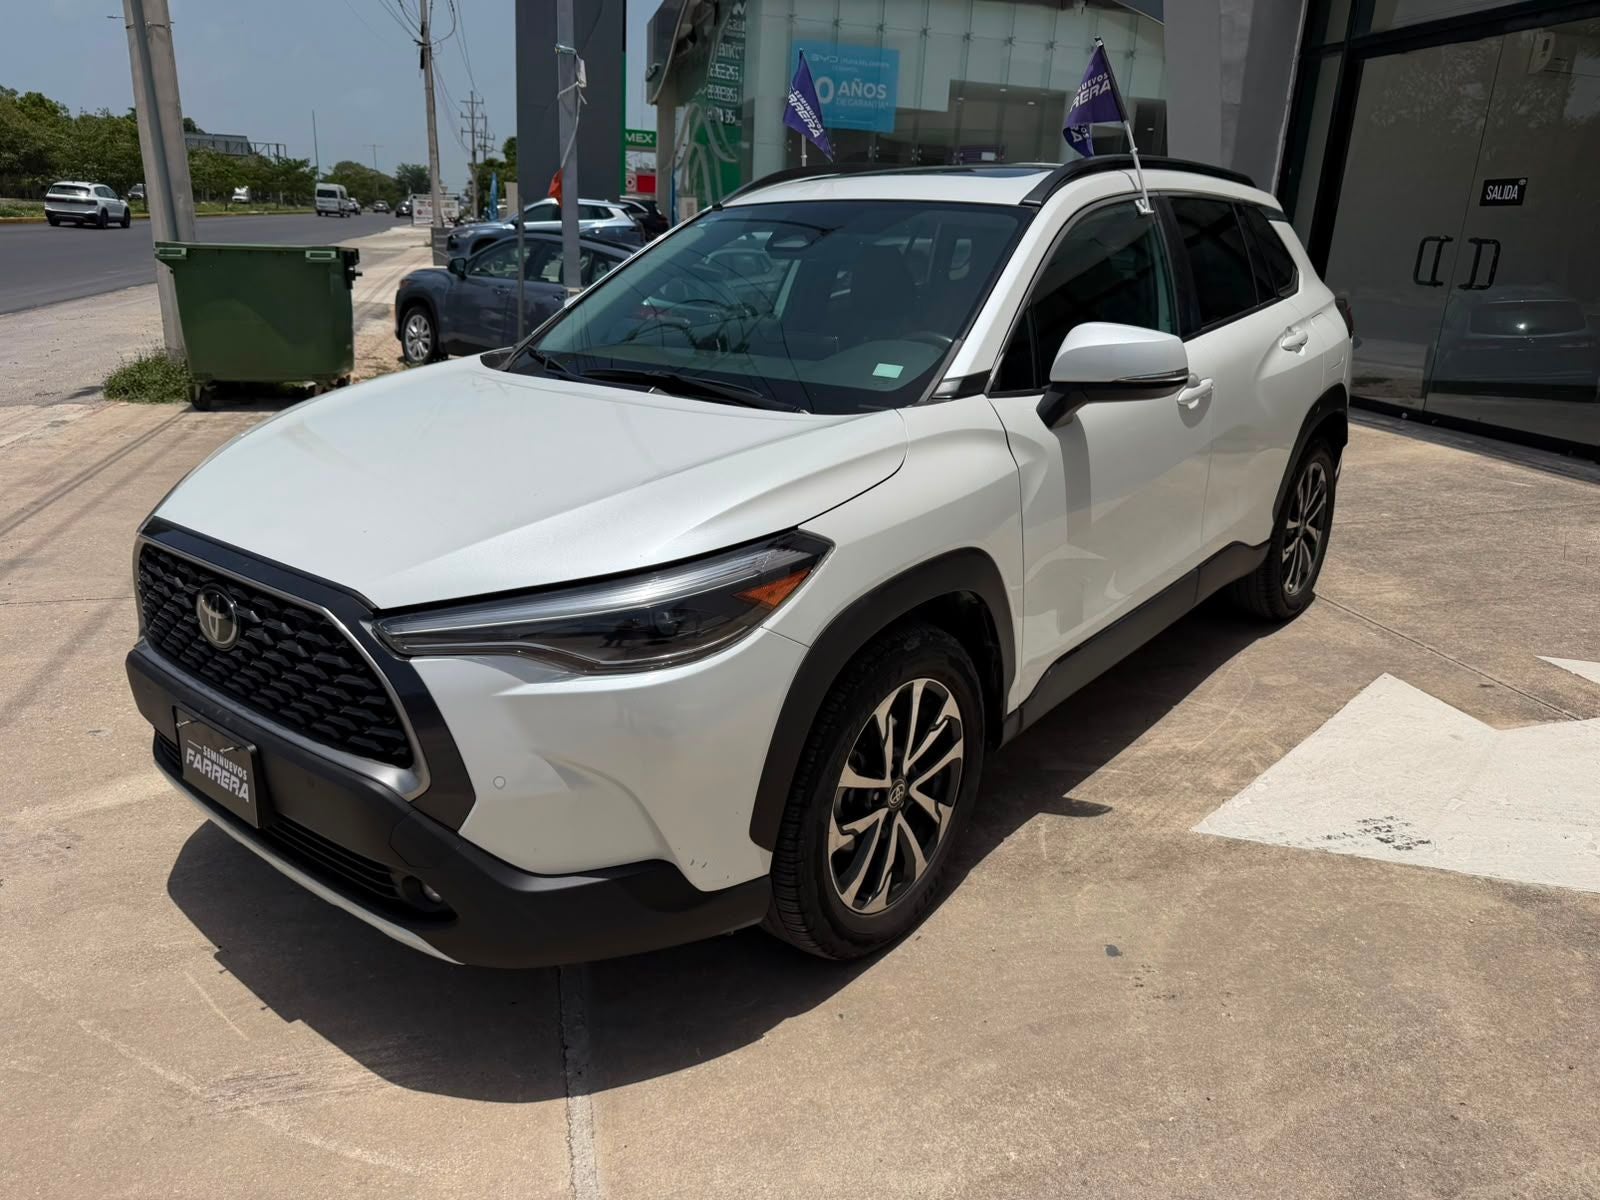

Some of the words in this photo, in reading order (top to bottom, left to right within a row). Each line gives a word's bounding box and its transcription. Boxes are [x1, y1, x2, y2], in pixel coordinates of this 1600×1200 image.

[839, 78, 887, 99] AÑOS
[788, 93, 820, 138] RRERA
[794, 90, 824, 133] SEMINUEVOS
[1486, 184, 1519, 200] SALIDA
[186, 748, 249, 802] FARRERA
[203, 745, 247, 780] SEMINUEVOS
